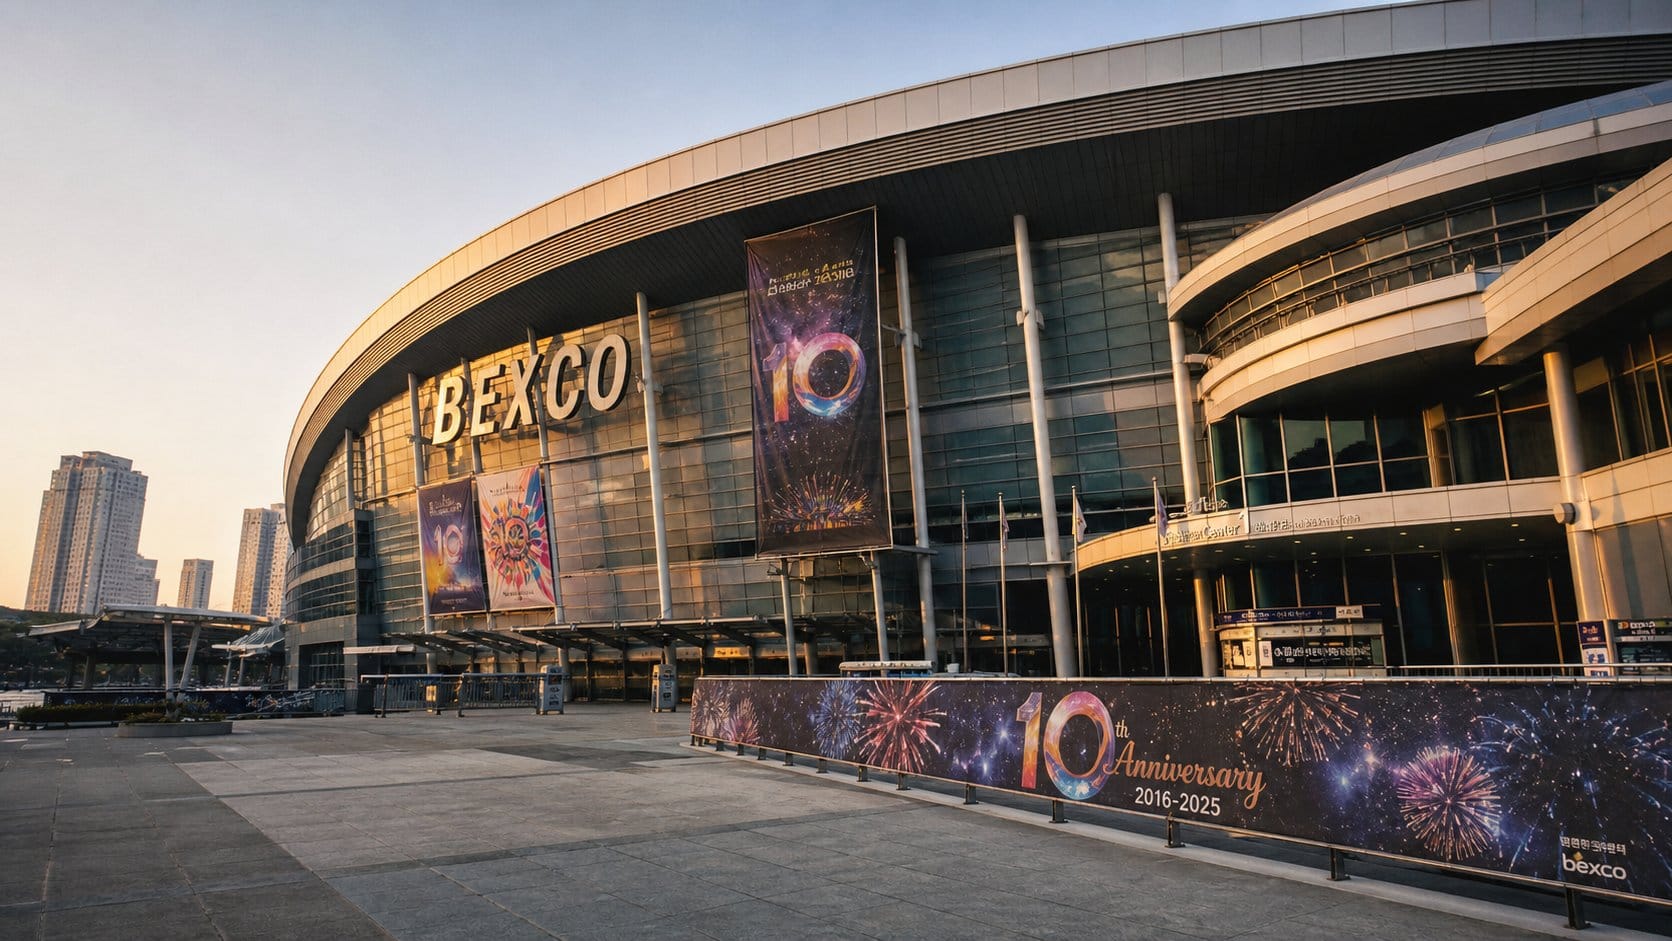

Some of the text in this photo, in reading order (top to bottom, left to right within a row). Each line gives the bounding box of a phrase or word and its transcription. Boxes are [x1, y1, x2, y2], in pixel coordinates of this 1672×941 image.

[432, 334, 631, 445] BEXCO
[762, 332, 867, 423] 10
[434, 524, 464, 566] 10
[1015, 691, 1129, 800] 10 th
[1103, 740, 1266, 809] Anniversary
[1135, 786, 1221, 817] 2016-2025
[1562, 852, 1627, 880] bexco
